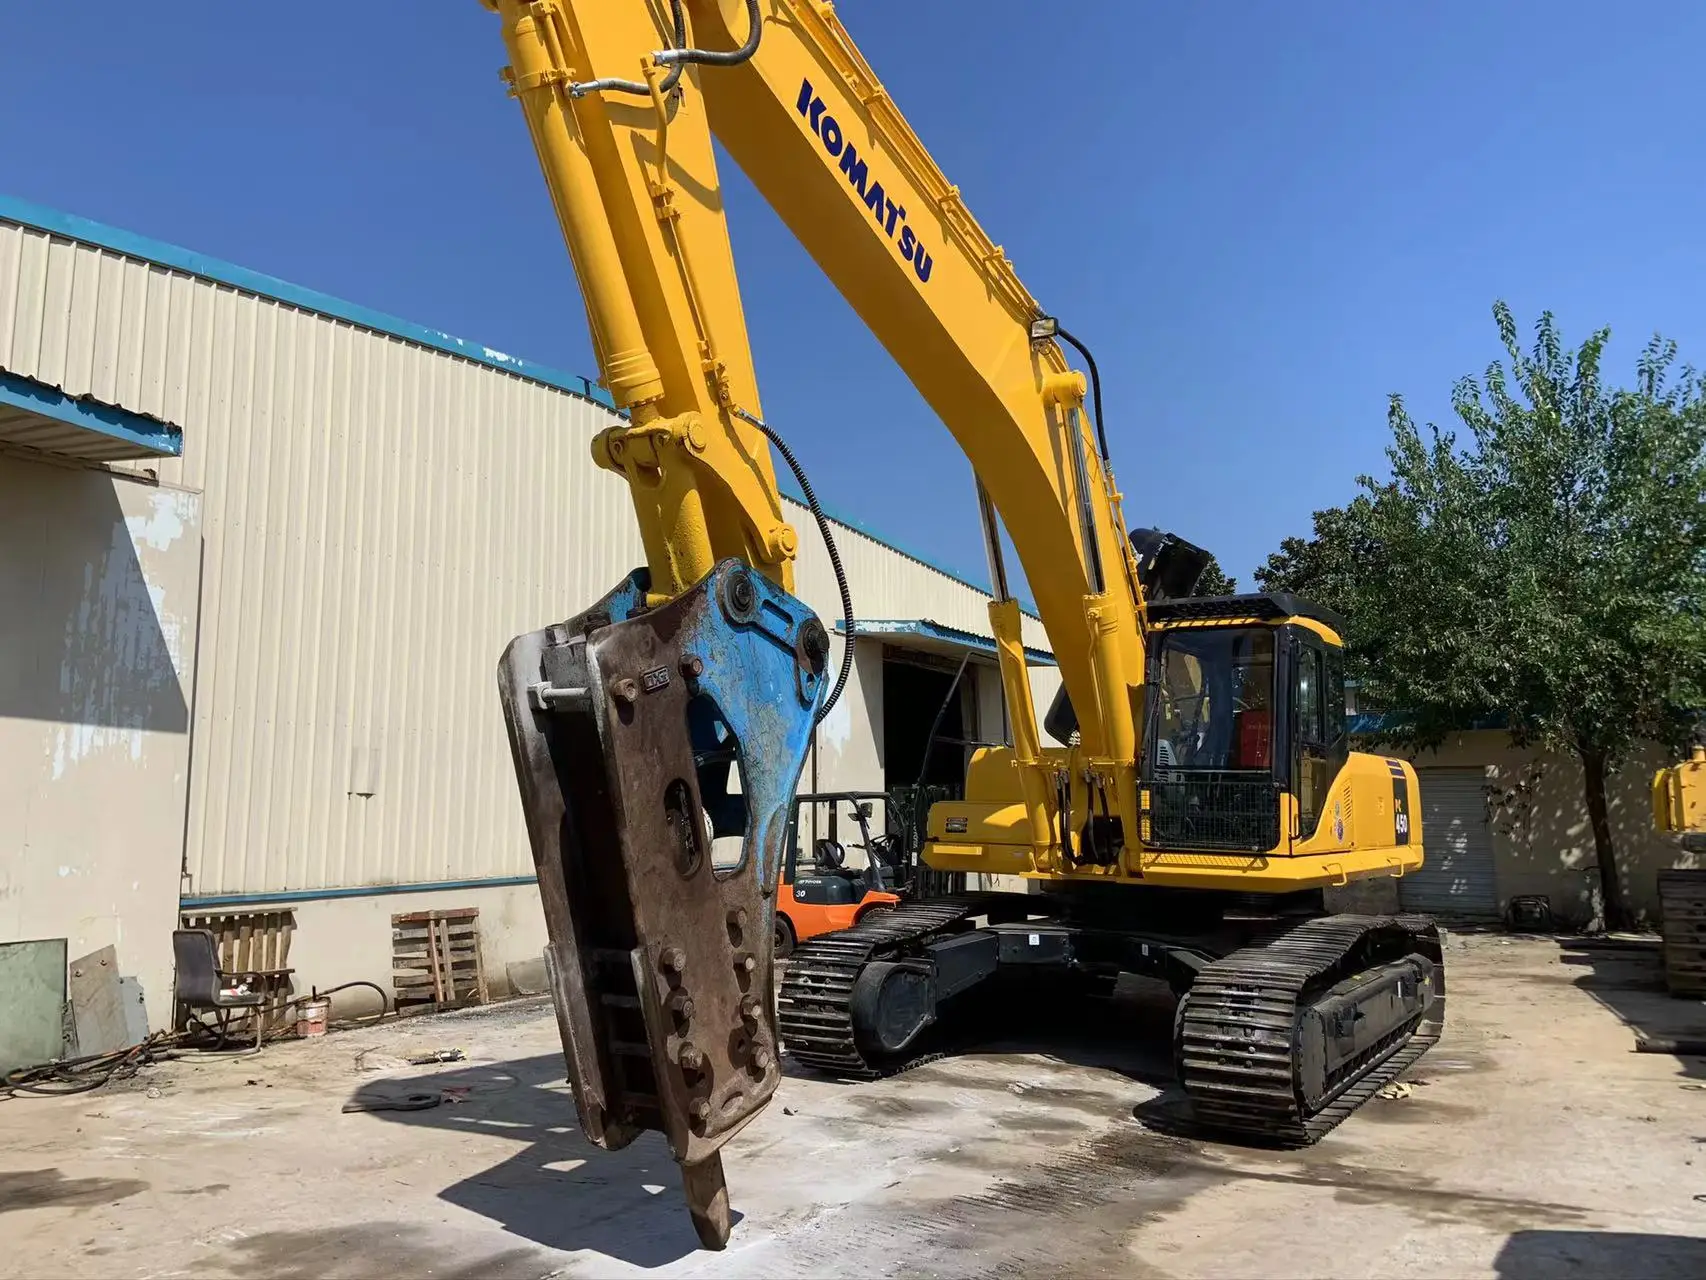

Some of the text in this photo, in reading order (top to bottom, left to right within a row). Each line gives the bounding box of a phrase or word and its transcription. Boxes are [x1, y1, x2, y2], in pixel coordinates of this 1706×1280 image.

[796, 77, 933, 283] KOMATSU
[1396, 813, 1408, 835] 450
[795, 889, 806, 898] 30
